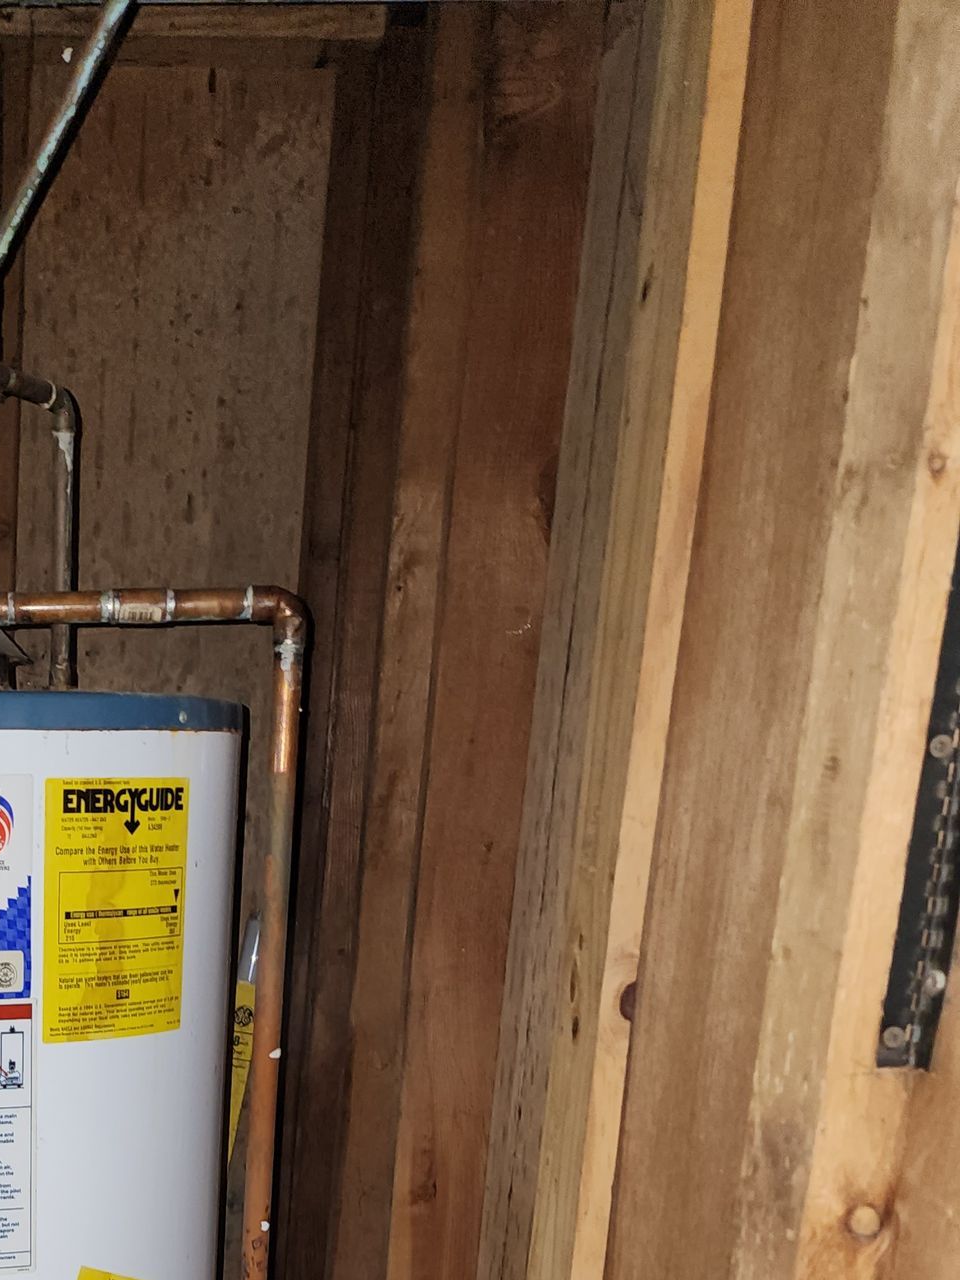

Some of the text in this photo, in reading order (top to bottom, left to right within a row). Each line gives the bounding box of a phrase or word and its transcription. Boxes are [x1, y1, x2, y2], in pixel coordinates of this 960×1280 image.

[63, 787, 184, 813] ENERGYGUIDE
[56, 846, 83, 856] Compare
[86, 846, 95, 854] the
[98, 846, 117, 856] Energy
[120, 846, 130, 854] Use
[98, 856, 117, 865] Others
[119, 856, 136, 865] Before
